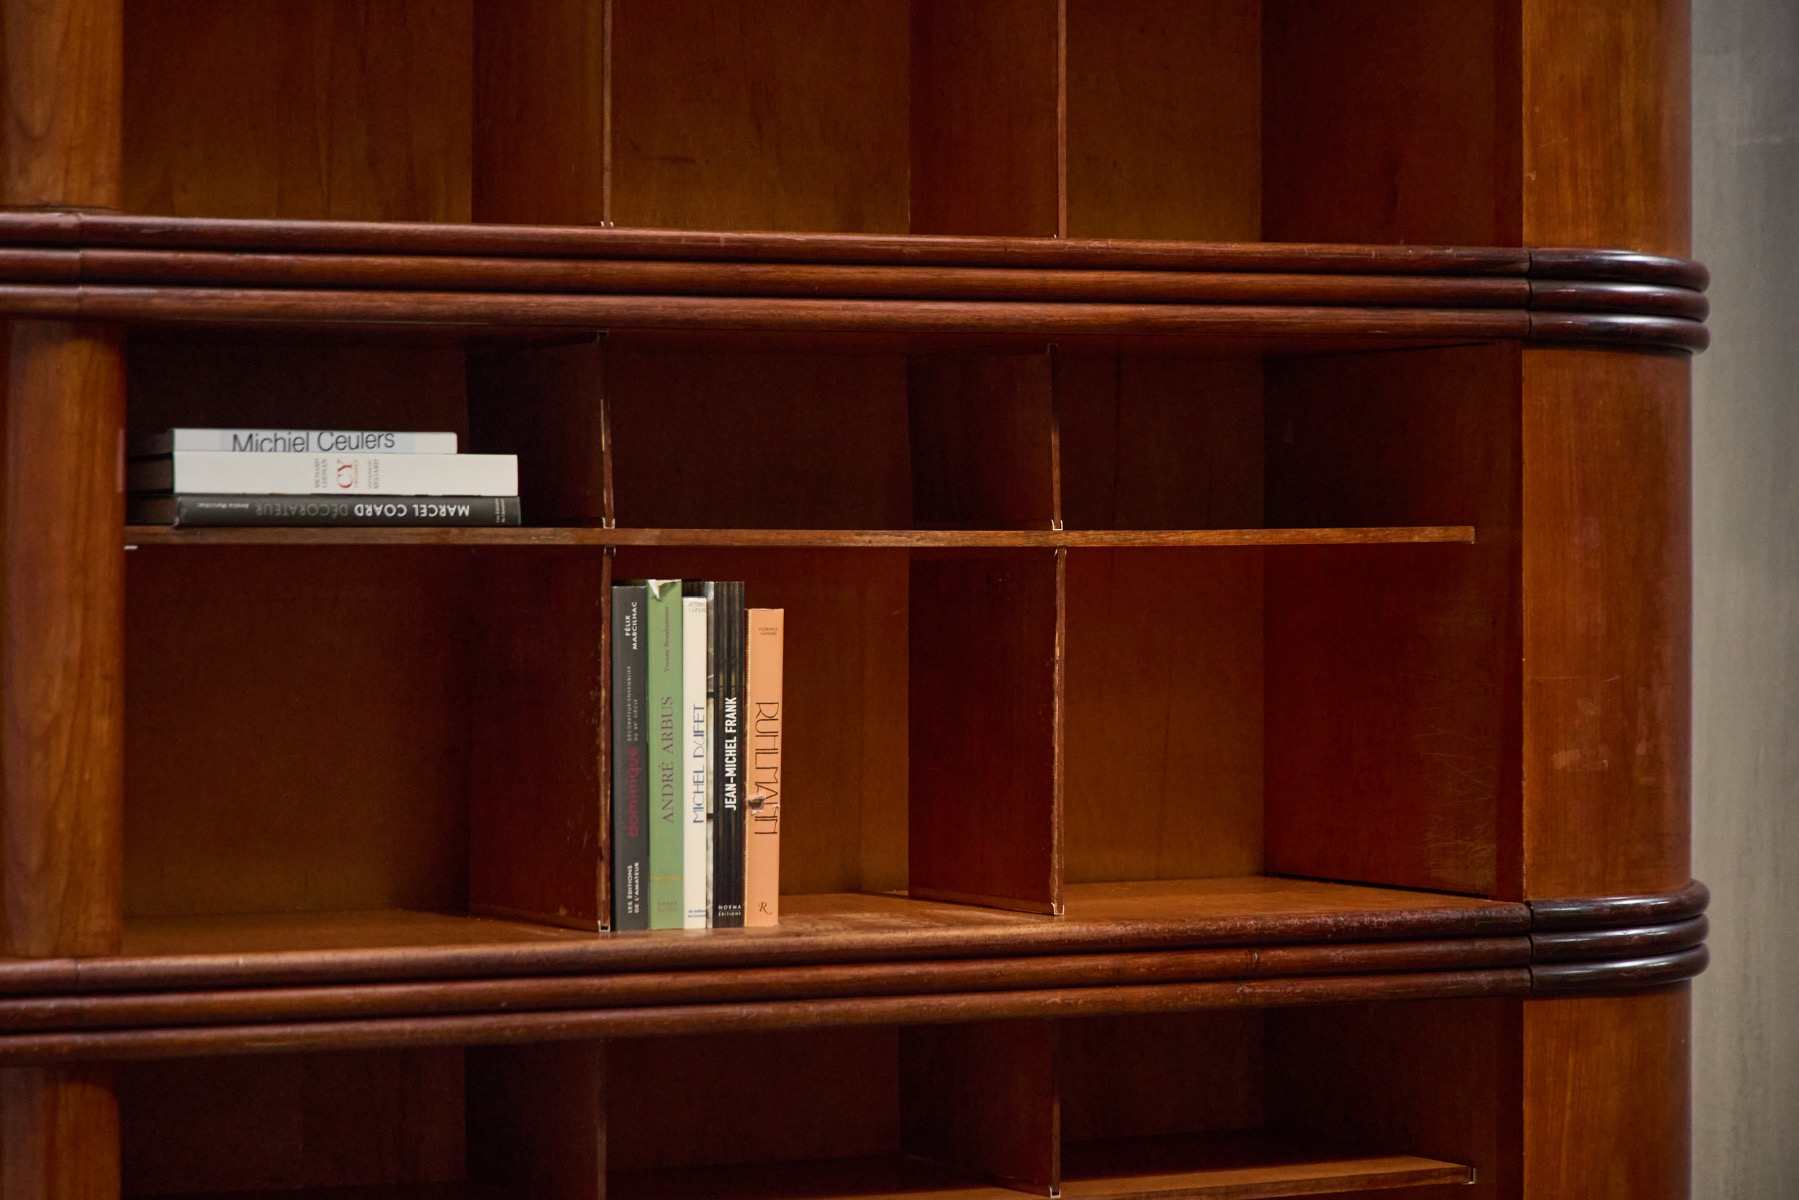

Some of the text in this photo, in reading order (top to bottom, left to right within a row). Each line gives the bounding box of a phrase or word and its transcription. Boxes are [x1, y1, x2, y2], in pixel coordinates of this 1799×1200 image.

[232, 431, 395, 452] Michiel Ceulers
[336, 459, 353, 488] CY
[255, 502, 348, 519] DÉCORATEUR
[354, 503, 408, 517] COARD
[412, 504, 470, 517] MARCEL
[658, 696, 674, 824] ANDRÉ ARBUS
[693, 703, 705, 823] MICHEL DUFET
[725, 697, 737, 811] JEAN-MICHEL FRANK
[754, 702, 779, 835] RUHLMANN
[624, 747, 642, 837] dominique
[634, 903, 640, 913] DE
